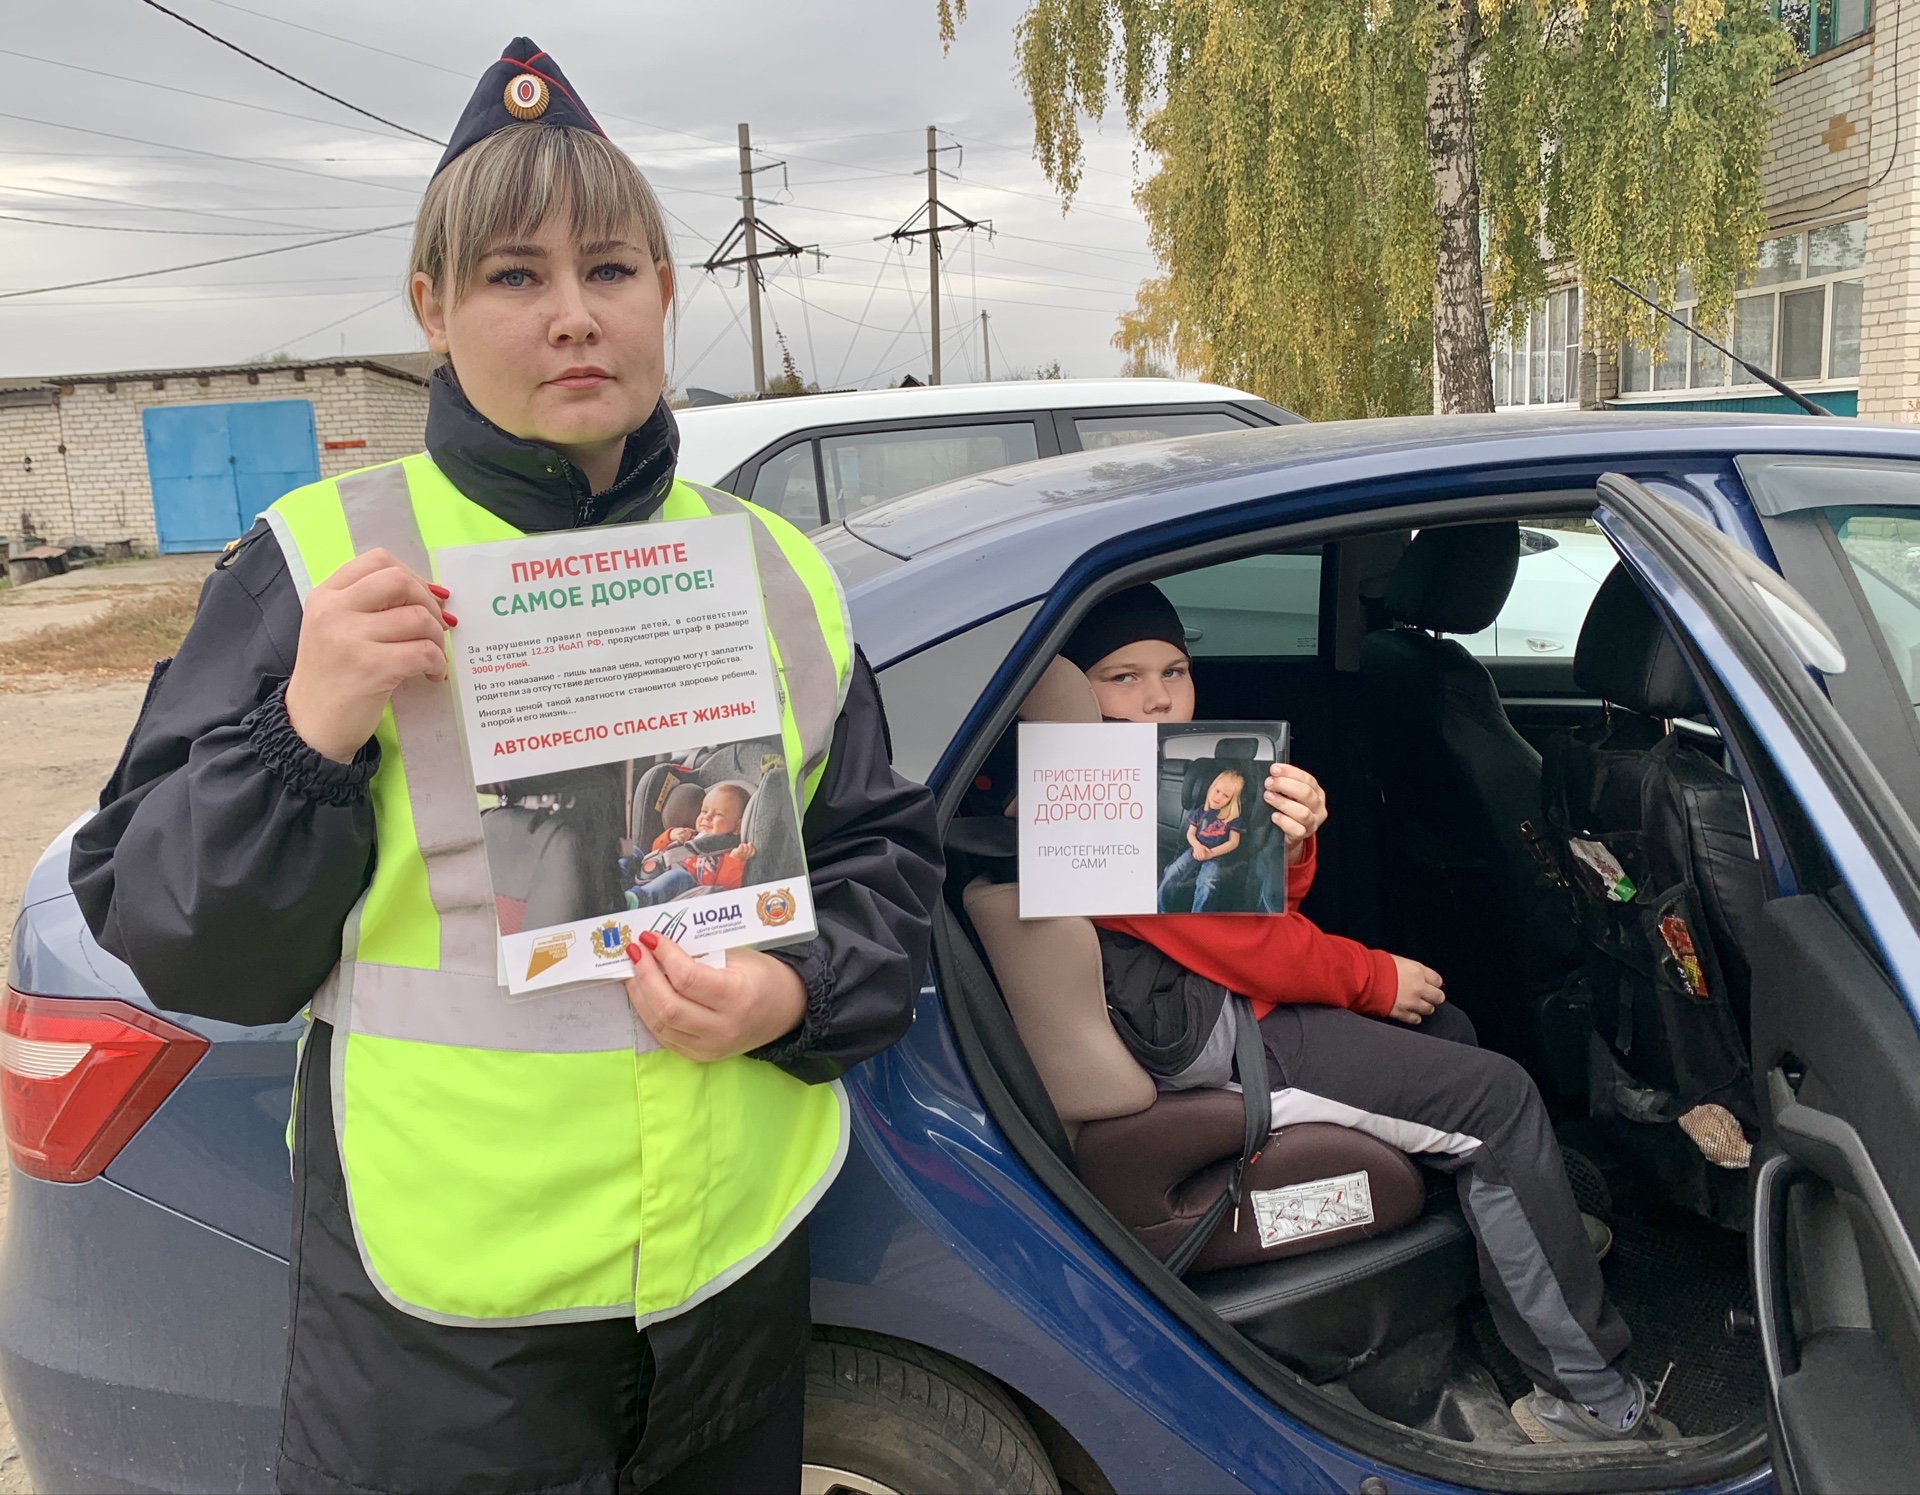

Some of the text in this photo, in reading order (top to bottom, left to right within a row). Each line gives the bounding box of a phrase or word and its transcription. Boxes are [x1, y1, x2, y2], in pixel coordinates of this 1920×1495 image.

[511, 543, 688, 584] ПРИСТЕГНИТЕ
[492, 569, 715, 617] САМОЕ ДОРОГОЕ!
[468, 646, 480, 654] За
[486, 638, 541, 652] нарушение
[546, 632, 581, 643] правил
[586, 625, 636, 637] перевозки
[641, 620, 670, 630] детей,
[686, 609, 748, 623] соответствии
[479, 654, 492, 663] ч.3
[497, 650, 526, 660] статьи
[531, 646, 554, 655] 12.23
[558, 641, 584, 651] КоАП
[587, 639, 604, 647] РФ,
[608, 631, 669, 645] предусмотрен
[673, 625, 702, 636] штраф
[715, 618, 749, 630] размере
[471, 659, 530, 674] 3000 рублей.
[474, 682, 487, 691] Но
[508, 674, 554, 686] наказание
[564, 670, 586, 678] лишь
[589, 664, 616, 674] малая
[619, 661, 642, 670] цена,
[644, 655, 681, 666] которую
[683, 650, 708, 660] могут
[711, 644, 753, 656] заплатить
[476, 655, 742, 703] родители за отсутствие детского удерживающего устройства.
[479, 669, 757, 718] Иногда ценой такой халатности становится здоровье ребенка,
[487, 715, 515, 727] порой
[524, 713, 538, 722] его
[493, 725, 608, 756] АВТОКРЕСЛО
[614, 712, 688, 736] СПАСАЕТ
[693, 701, 756, 724] ЖИЗНЬ!
[1034, 769, 1141, 782] ПРИСТЕГНИТЕ
[1046, 783, 1132, 802] САМОГО
[1034, 802, 1143, 825] ДОРОГОГО
[1038, 844, 1140, 857] ПРИСТЕГНИТЕСЬ
[1072, 858, 1107, 869] САМИ
[693, 904, 742, 926] ЦОДД
